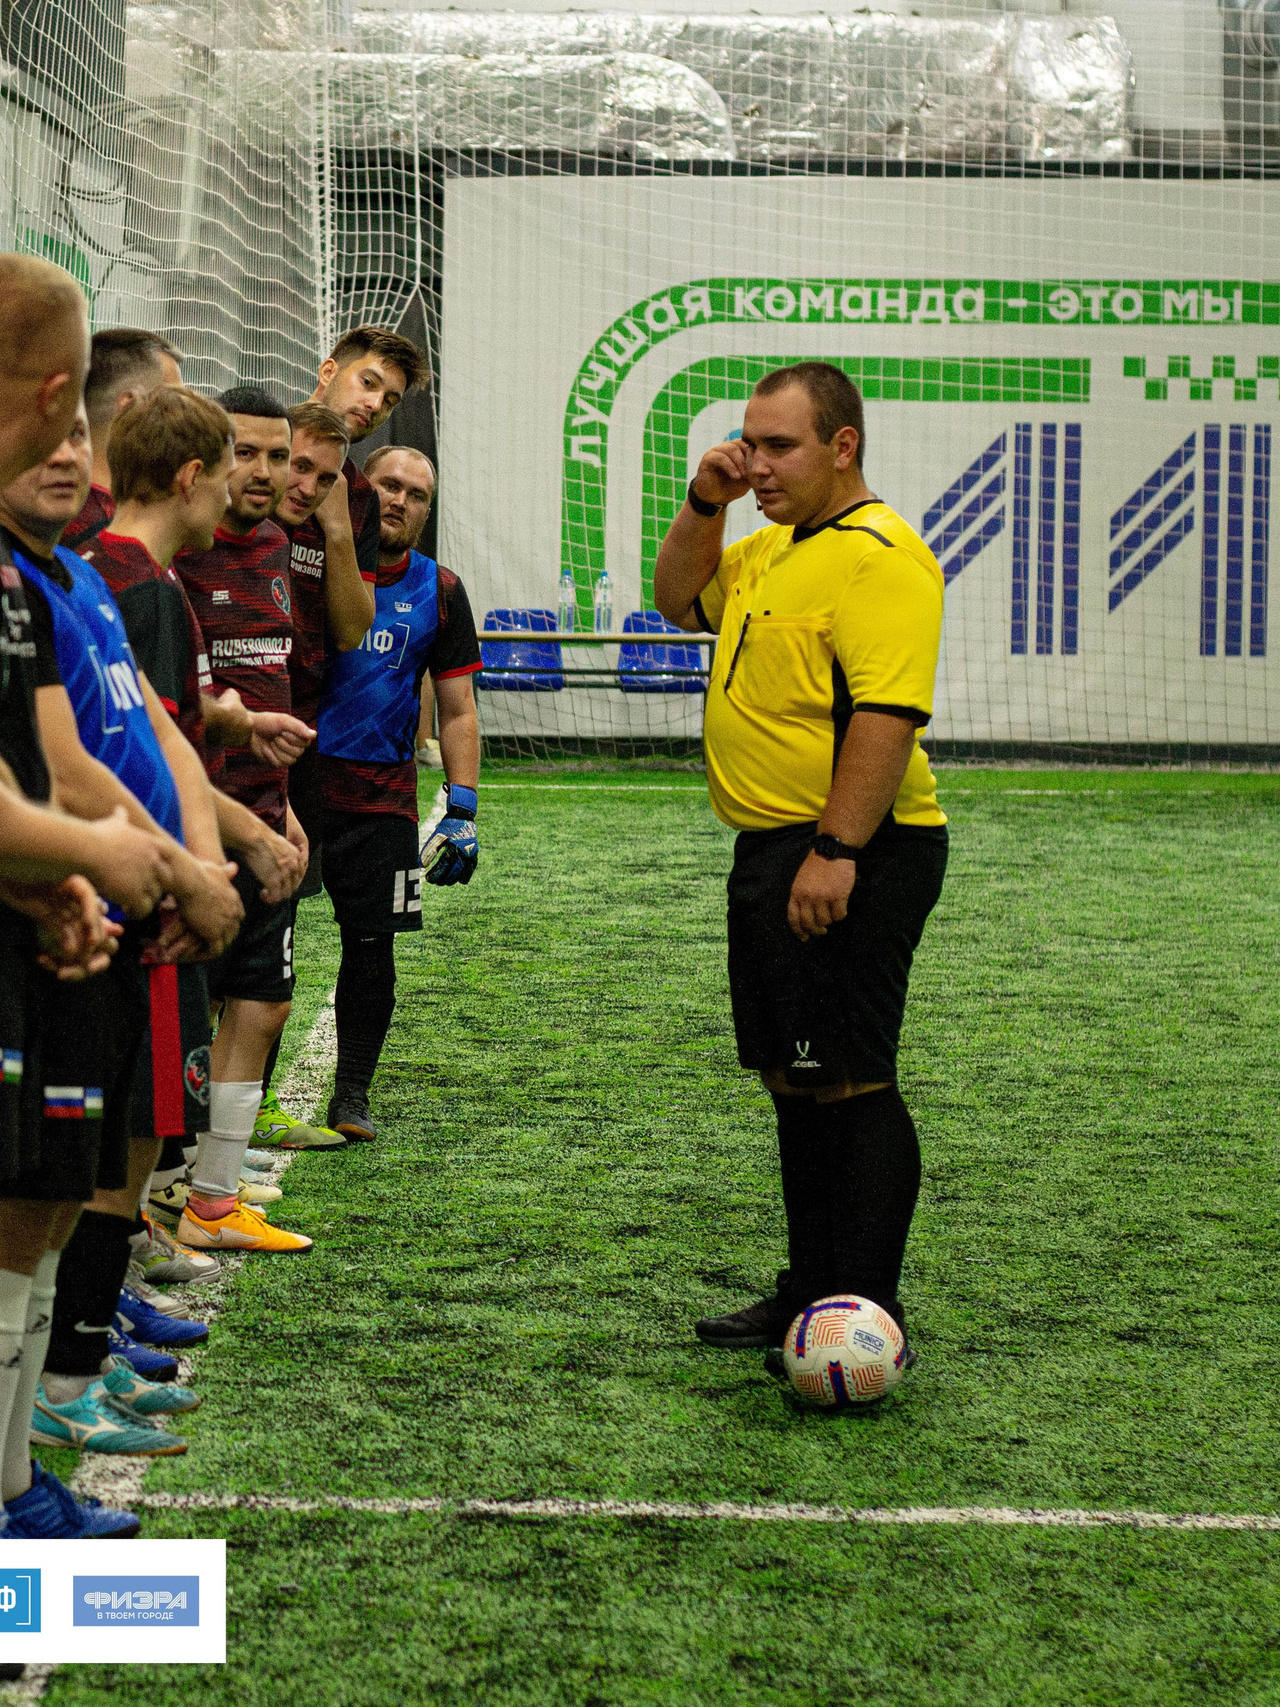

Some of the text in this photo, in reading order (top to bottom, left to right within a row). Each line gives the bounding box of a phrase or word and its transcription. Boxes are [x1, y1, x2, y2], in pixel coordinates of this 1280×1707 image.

[733, 285, 986, 324] команда
[1048, 287, 1145, 321] это
[1163, 288, 1244, 321] мы
